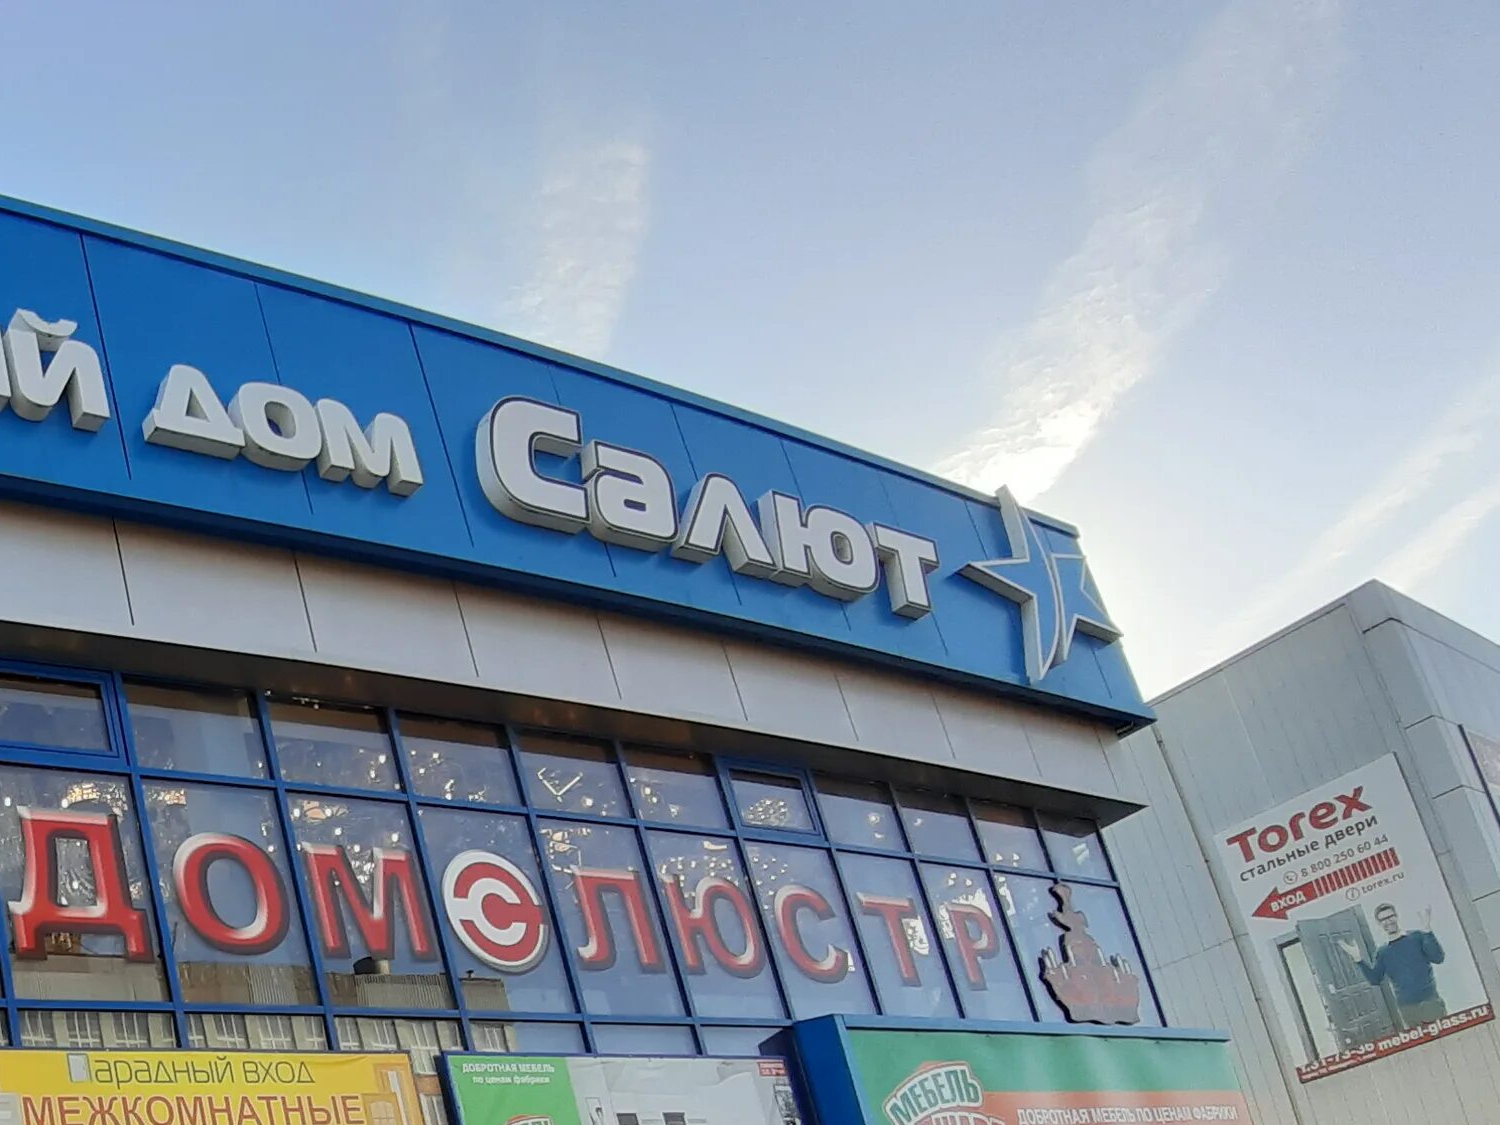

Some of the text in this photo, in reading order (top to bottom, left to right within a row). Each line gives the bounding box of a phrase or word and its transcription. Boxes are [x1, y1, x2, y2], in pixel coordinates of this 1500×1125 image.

[143, 364, 423, 497] ДОМ
[475, 396, 940, 620] Салют
[1226, 786, 1372, 863] Torex
[1240, 815, 1378, 882] стальные двери
[1311, 857, 1331, 873] 800
[1335, 849, 1354, 864] 250
[1357, 841, 1371, 854] 60
[1373, 834, 1389, 846] 44
[8, 806, 1002, 990] ДОМ ЛЮСТР
[1271, 891, 1306, 912] ВХОД
[1361, 871, 1405, 894] torex.ru
[1378, 1006, 1489, 1051] mebel-glass.ru
[1091, 1106, 1136, 1123] МЕБЕЛЬ
[1137, 1107, 1153, 1122] ПО
[1155, 1106, 1192, 1124] ЦЕНАМ
[1193, 1105, 1238, 1121] ФАБРИКИ
